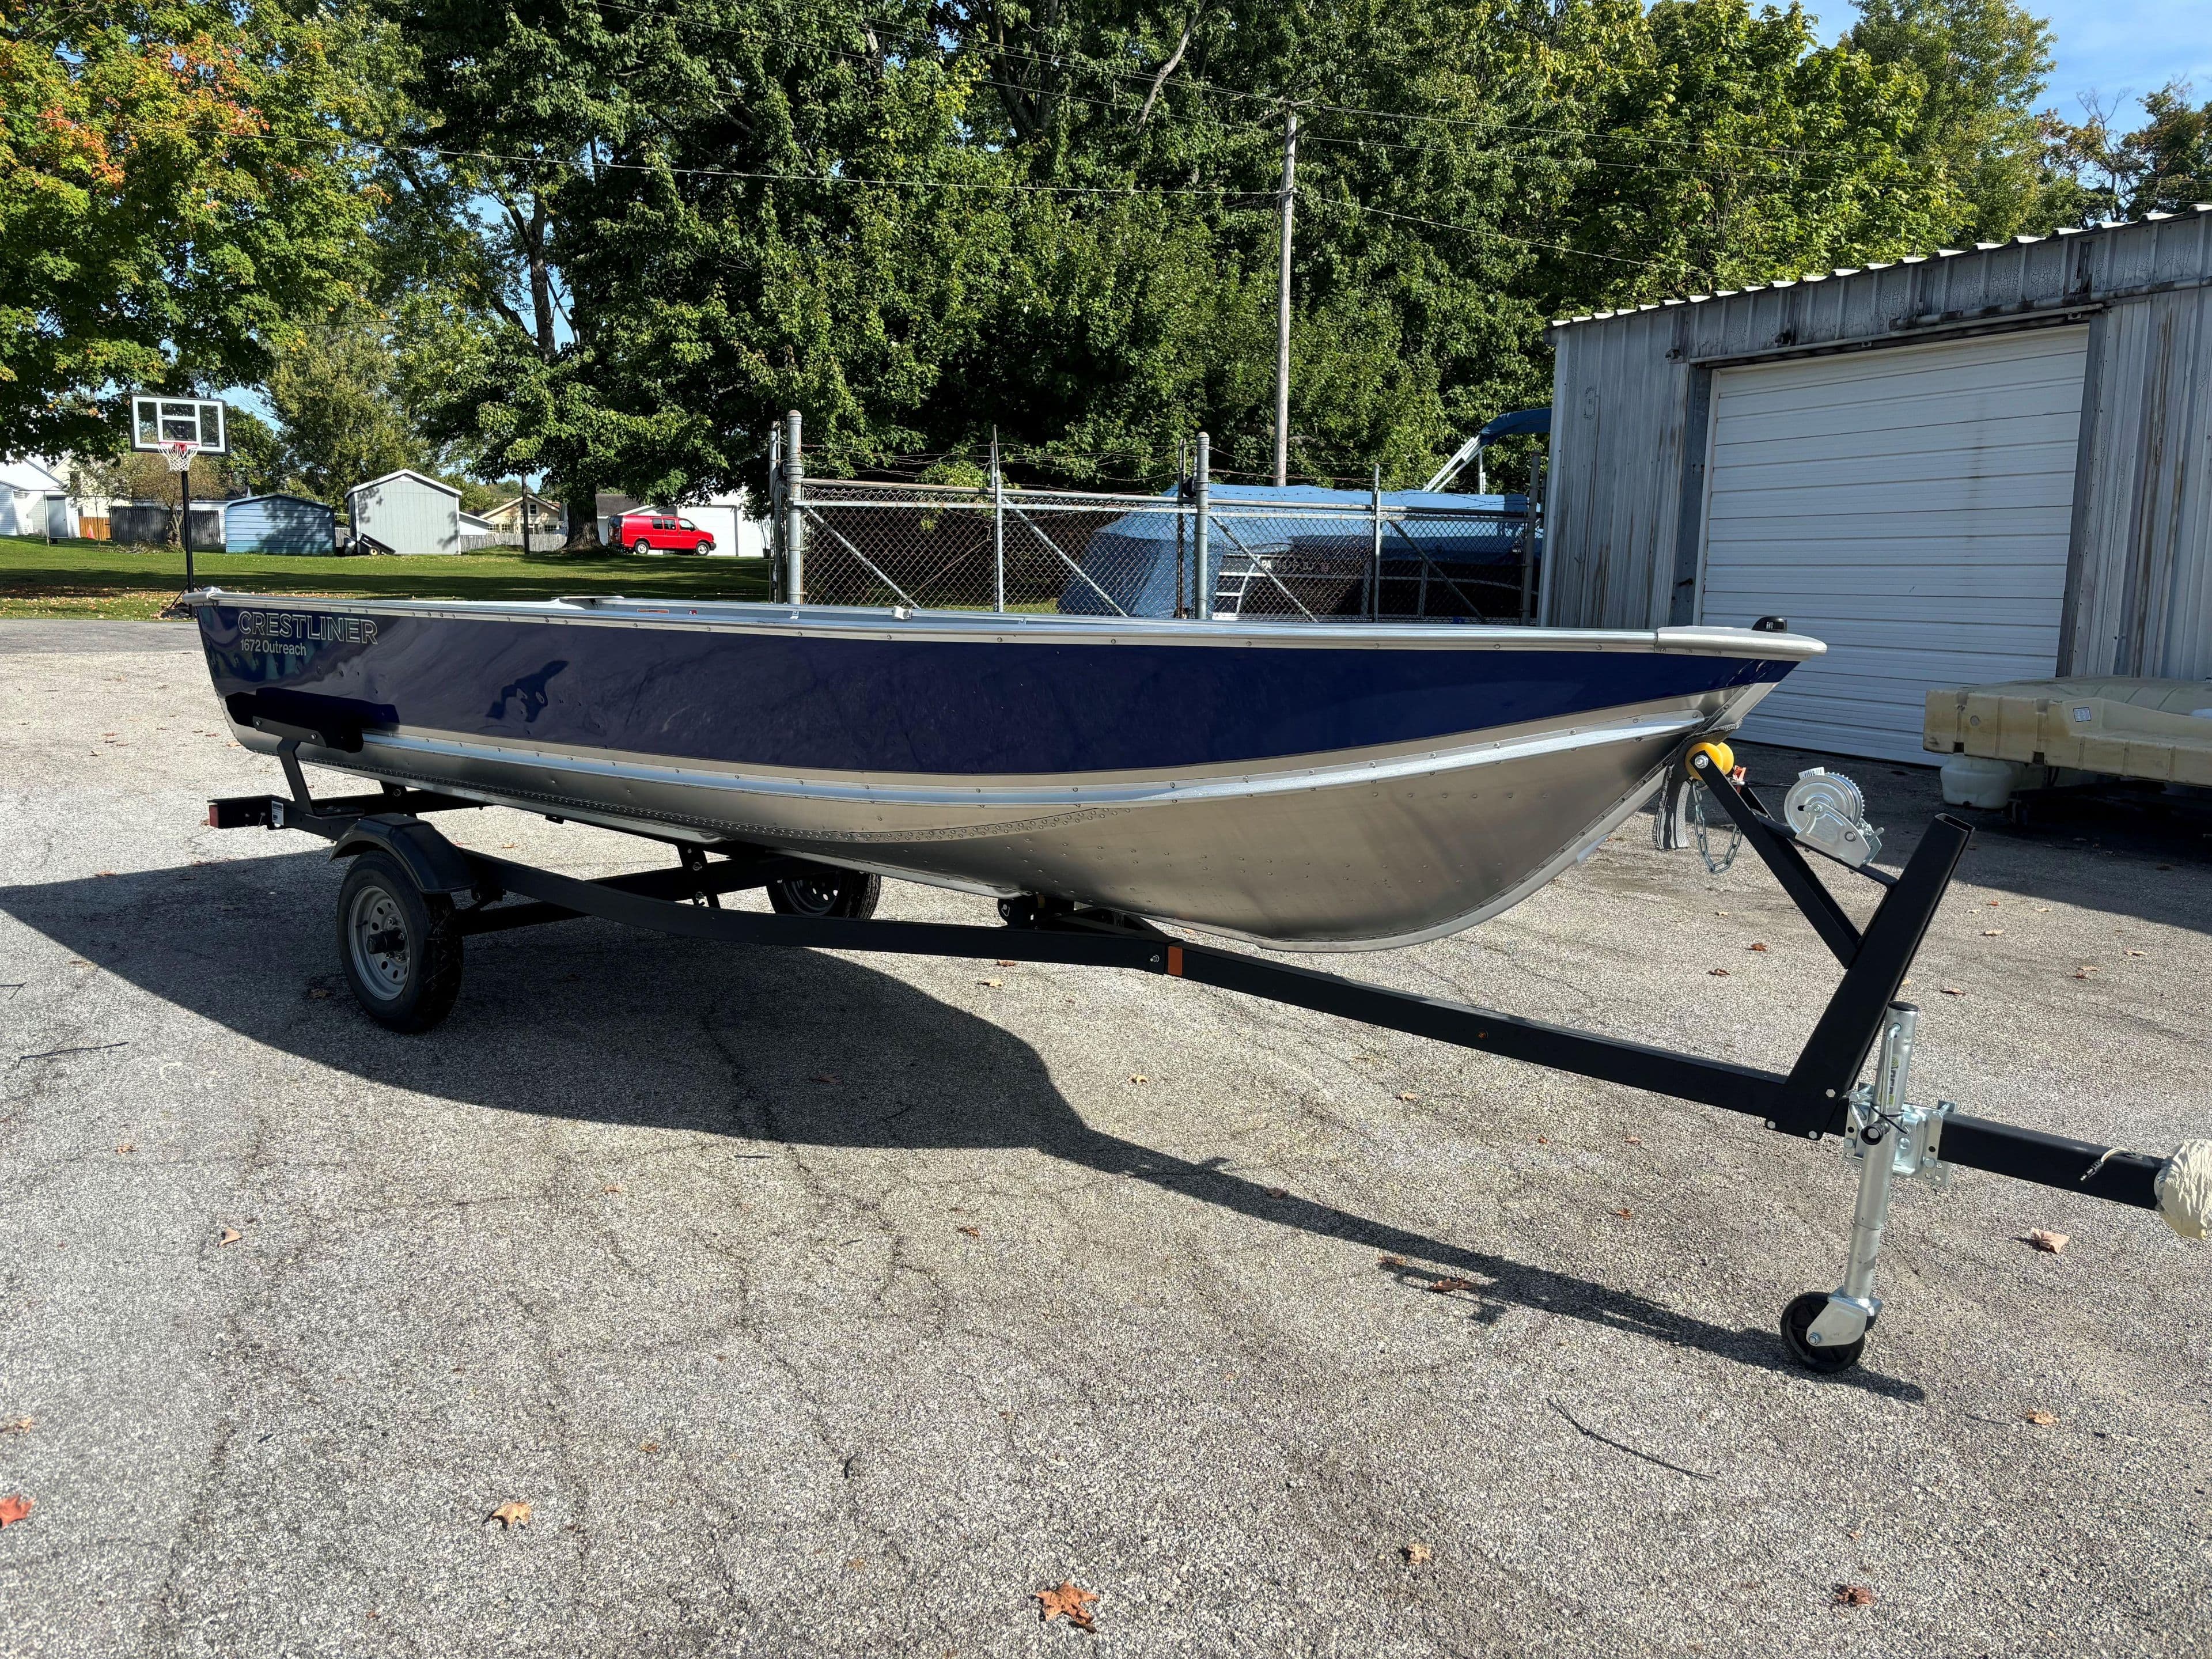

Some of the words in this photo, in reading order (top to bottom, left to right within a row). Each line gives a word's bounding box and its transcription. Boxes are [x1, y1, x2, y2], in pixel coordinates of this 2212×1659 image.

[1262, 560, 1272, 570] PA
[238, 611, 378, 645] CRESTLINER
[240, 638, 261, 652] 1672
[262, 640, 306, 656] Outreach
